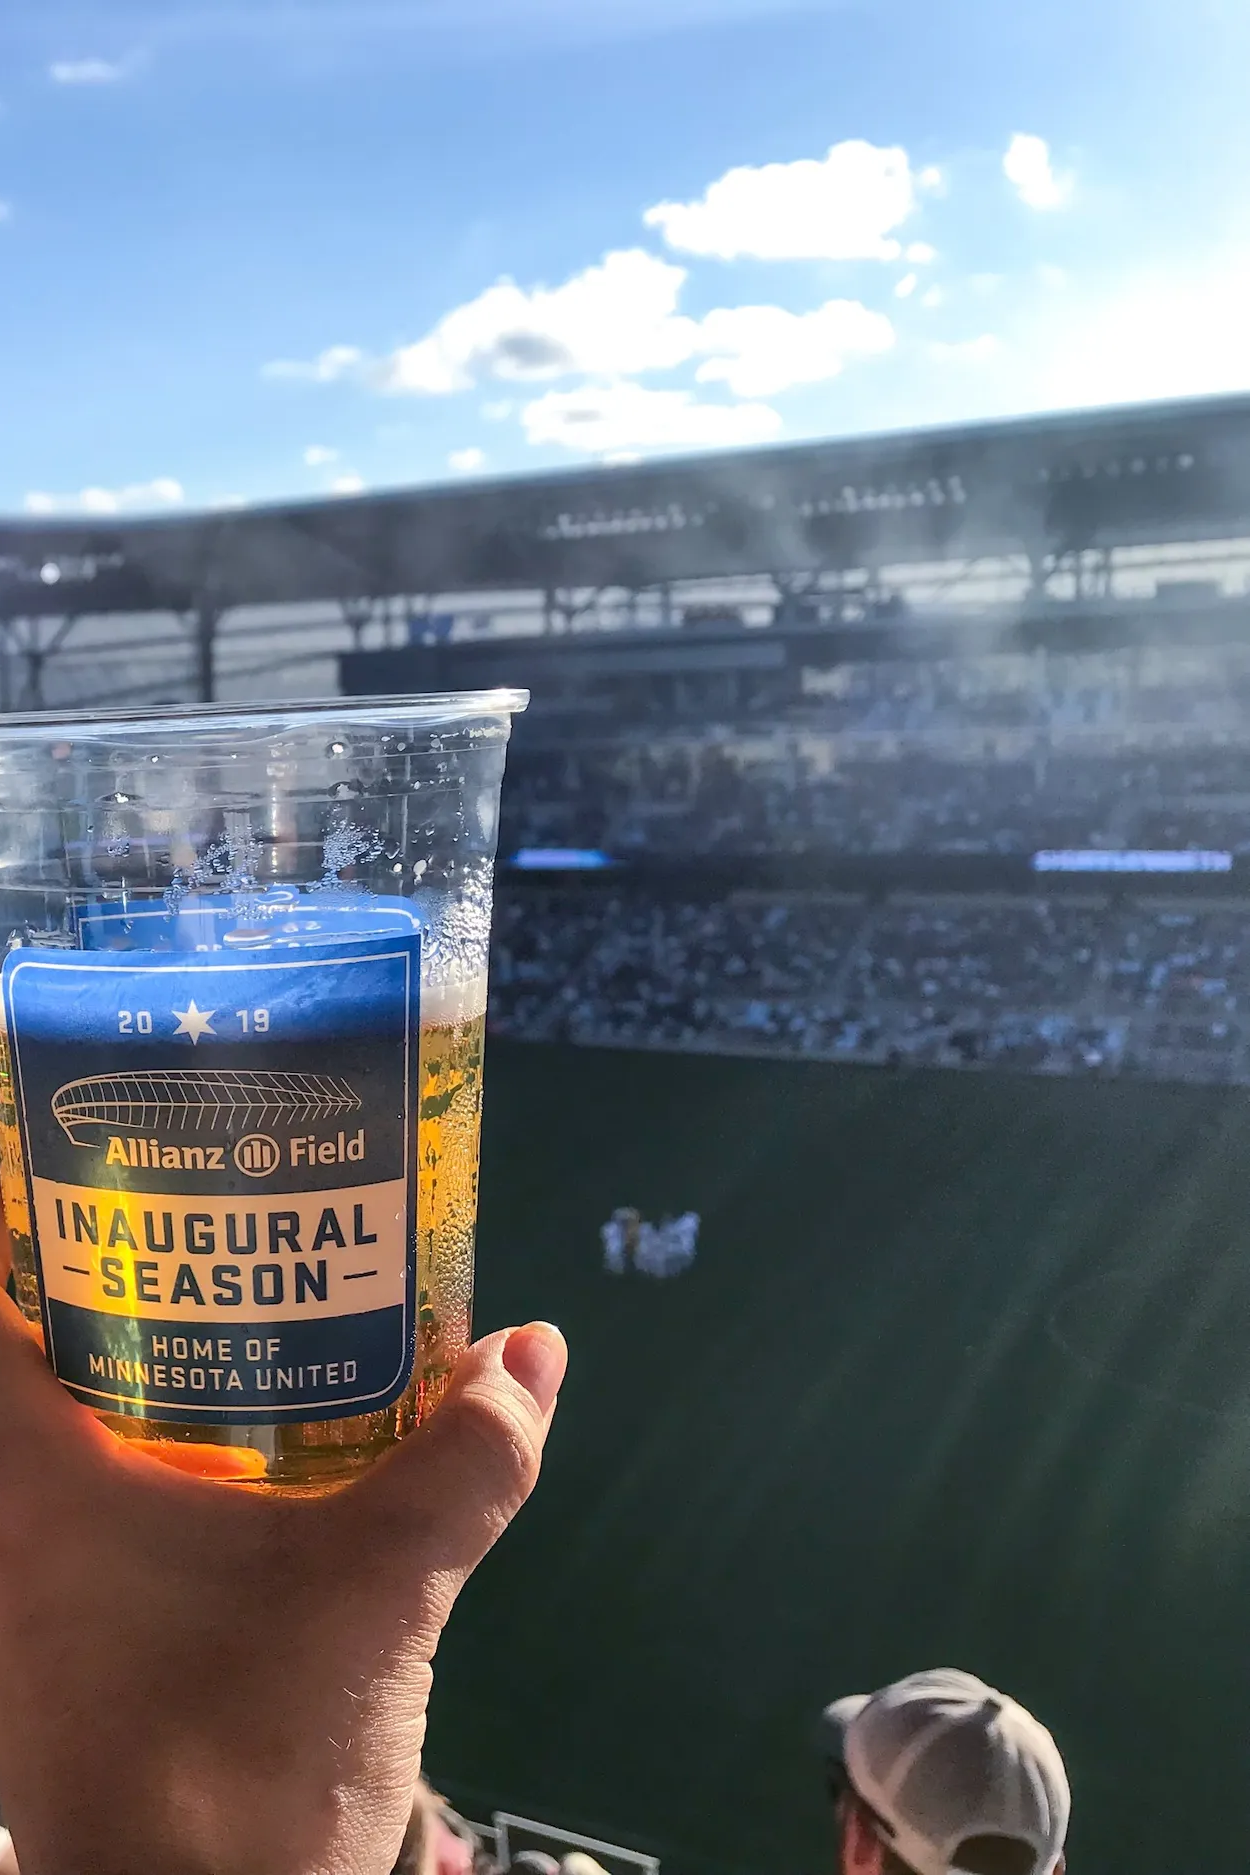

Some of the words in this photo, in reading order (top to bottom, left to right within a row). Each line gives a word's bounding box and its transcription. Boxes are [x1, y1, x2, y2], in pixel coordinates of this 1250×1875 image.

[117, 1010, 153, 1034] 20
[235, 1008, 270, 1033] 19
[105, 1136, 226, 1170] Allianz
[290, 1128, 366, 1167] Field
[55, 1198, 378, 1255] INAUGURAL
[101, 1257, 329, 1306] SEASON
[151, 1335, 233, 1362] HOME
[245, 1338, 281, 1361] OF
[89, 1352, 244, 1391] MINNESOTA
[256, 1360, 357, 1391] UNITED
